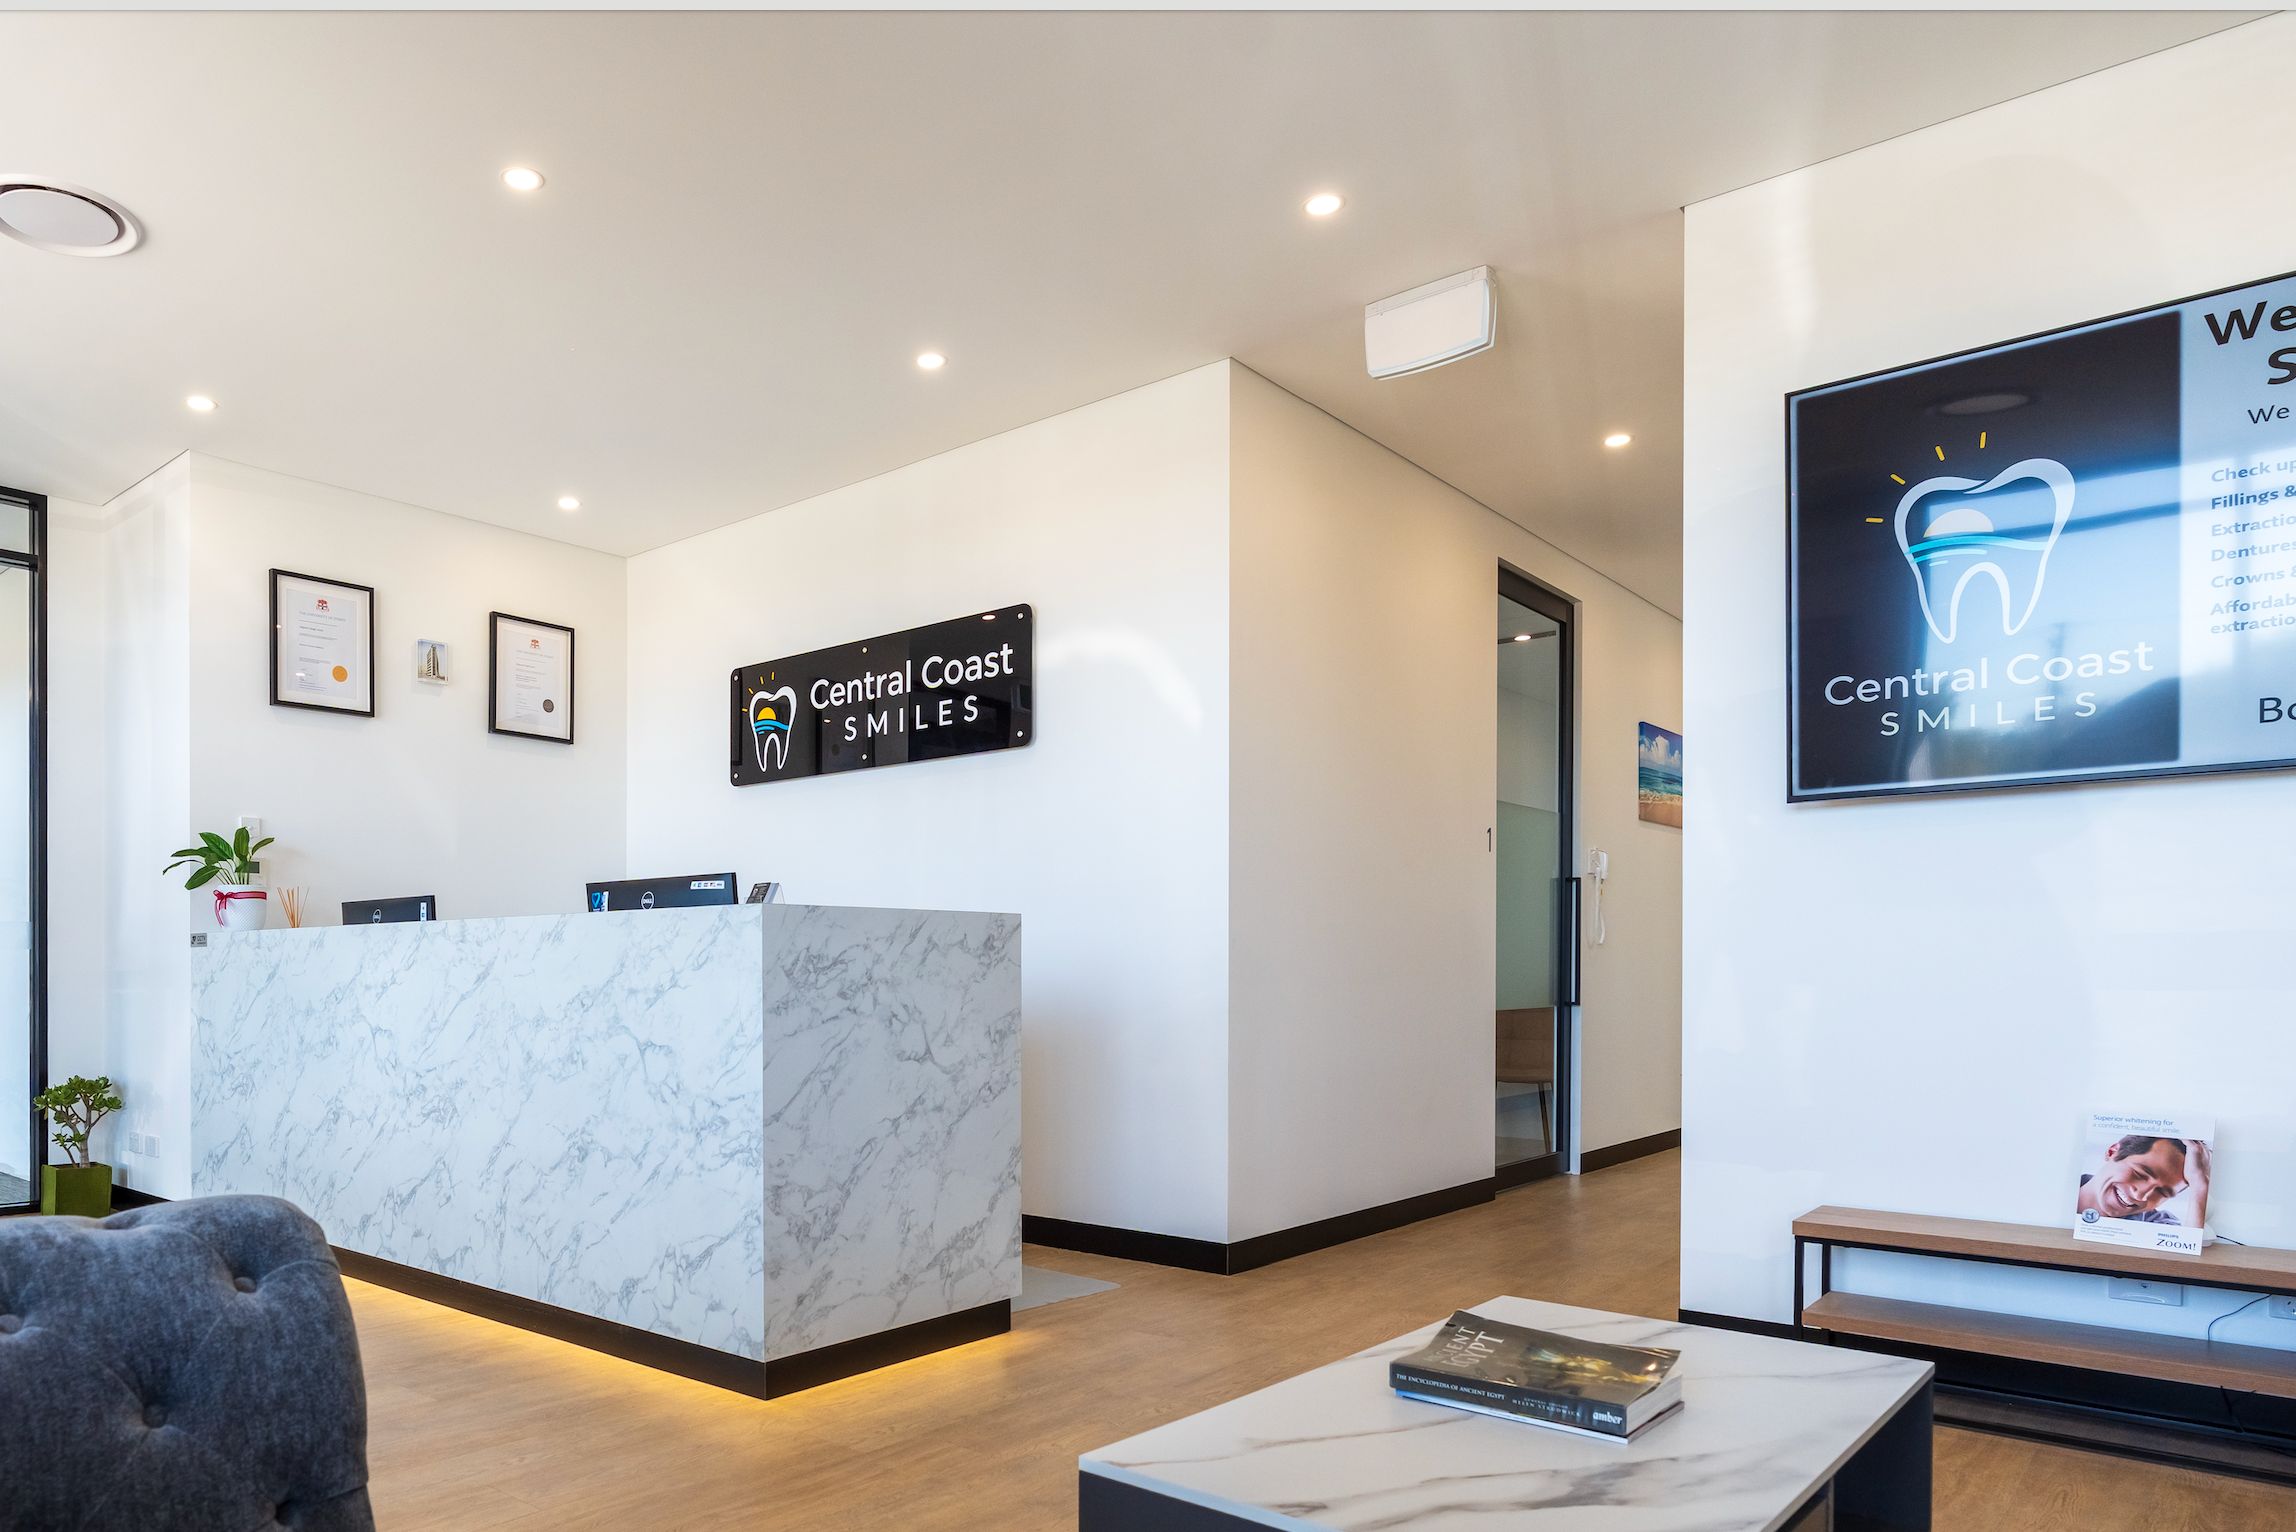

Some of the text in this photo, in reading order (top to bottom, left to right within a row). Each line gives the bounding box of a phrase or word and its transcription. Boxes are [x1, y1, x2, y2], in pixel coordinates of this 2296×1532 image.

[2248, 404, 2290, 424] We
[2211, 461, 2271, 482] Check
[2211, 487, 2279, 510] Fillings
[2211, 513, 2296, 537] Extractio
[2210, 568, 2285, 588] Crowns
[2210, 593, 2296, 616] Affordab
[2210, 614, 2295, 635] extractio
[810, 642, 1014, 710] Central Coast
[1824, 640, 2154, 707] Central Coast
[844, 694, 979, 742] SMILES
[1881, 691, 2097, 737] SMILES
[2093, 1114, 2123, 1122] Superior
[2125, 1117, 2161, 1126] whitening
[2156, 1239, 2196, 1251] ZOOM!
[1440, 1331, 1505, 1368] EGYPT
[1395, 1373, 1505, 1401] THE ENCYCLOPEDIA OF ANCIENT EGYPT
[1592, 1410, 1623, 1425] amber
